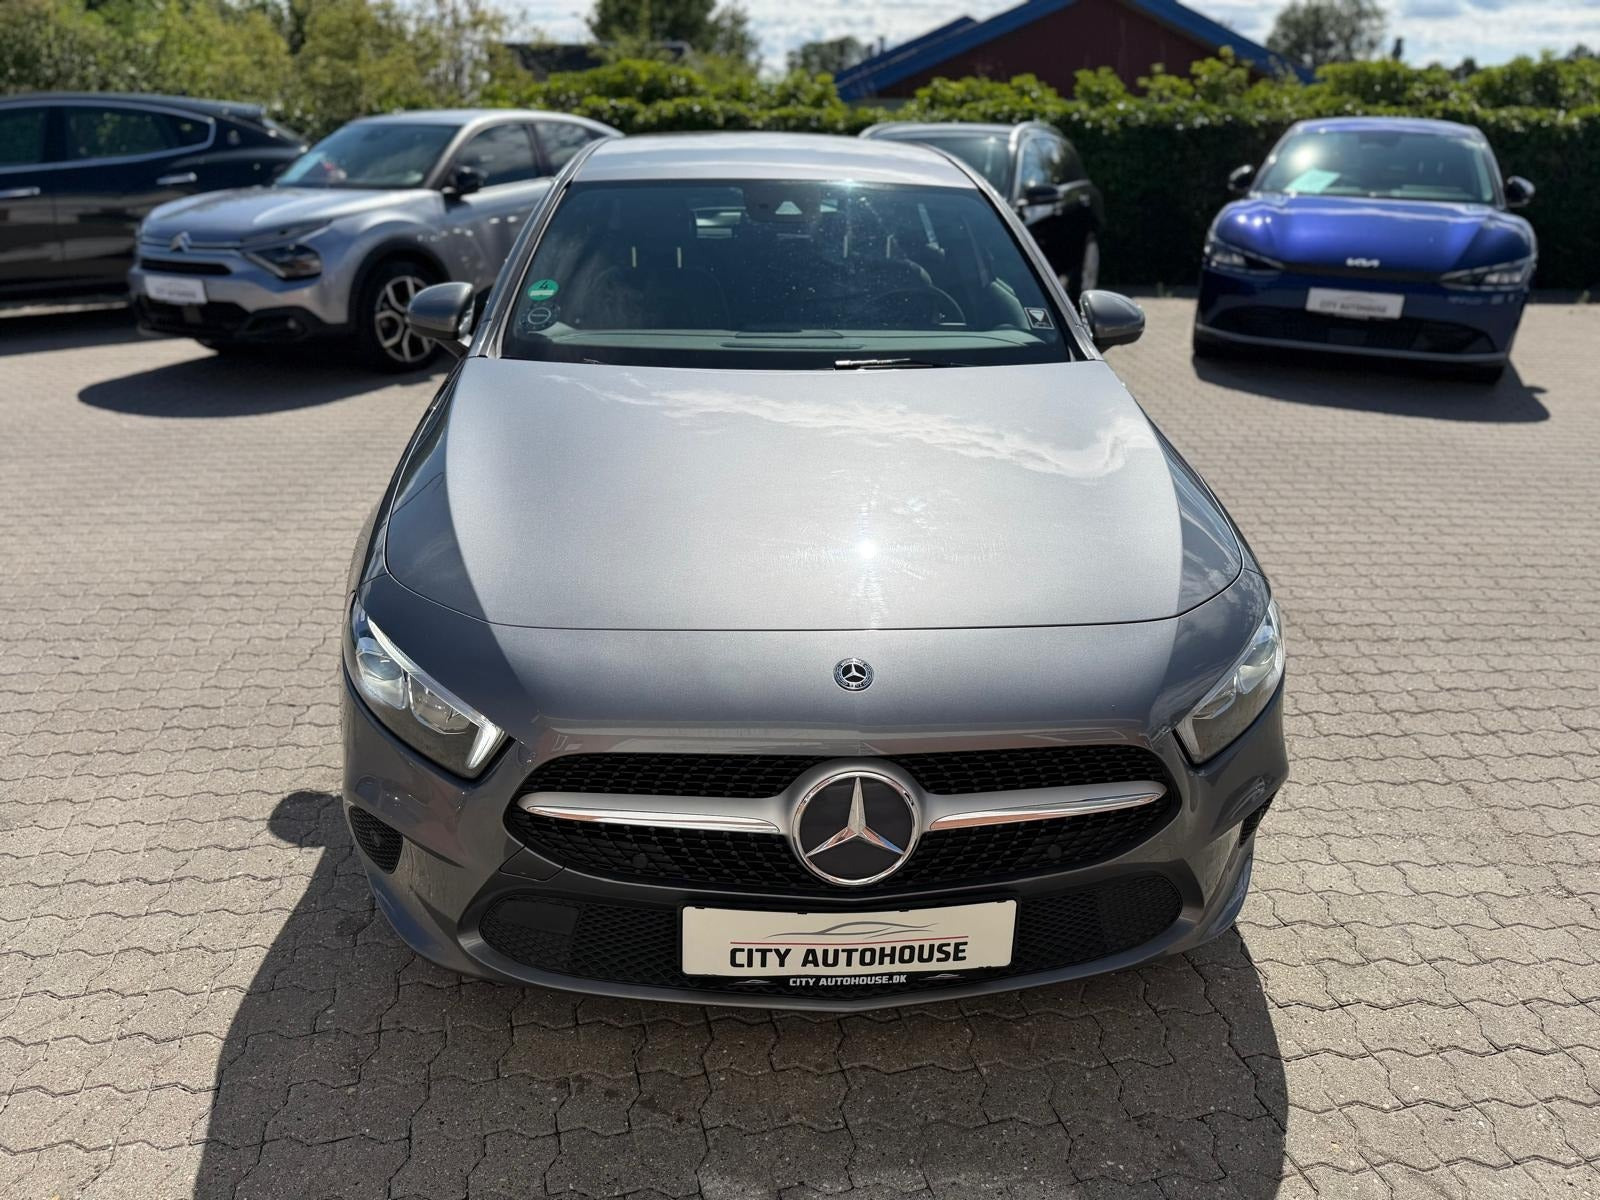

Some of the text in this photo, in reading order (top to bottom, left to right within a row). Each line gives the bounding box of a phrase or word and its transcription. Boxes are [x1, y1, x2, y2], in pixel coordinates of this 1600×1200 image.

[539, 280, 549, 289] 4
[730, 942, 968, 968] CITY AUTOHOUSE
[789, 974, 908, 986] CITY AUTOHOUSE.DK
